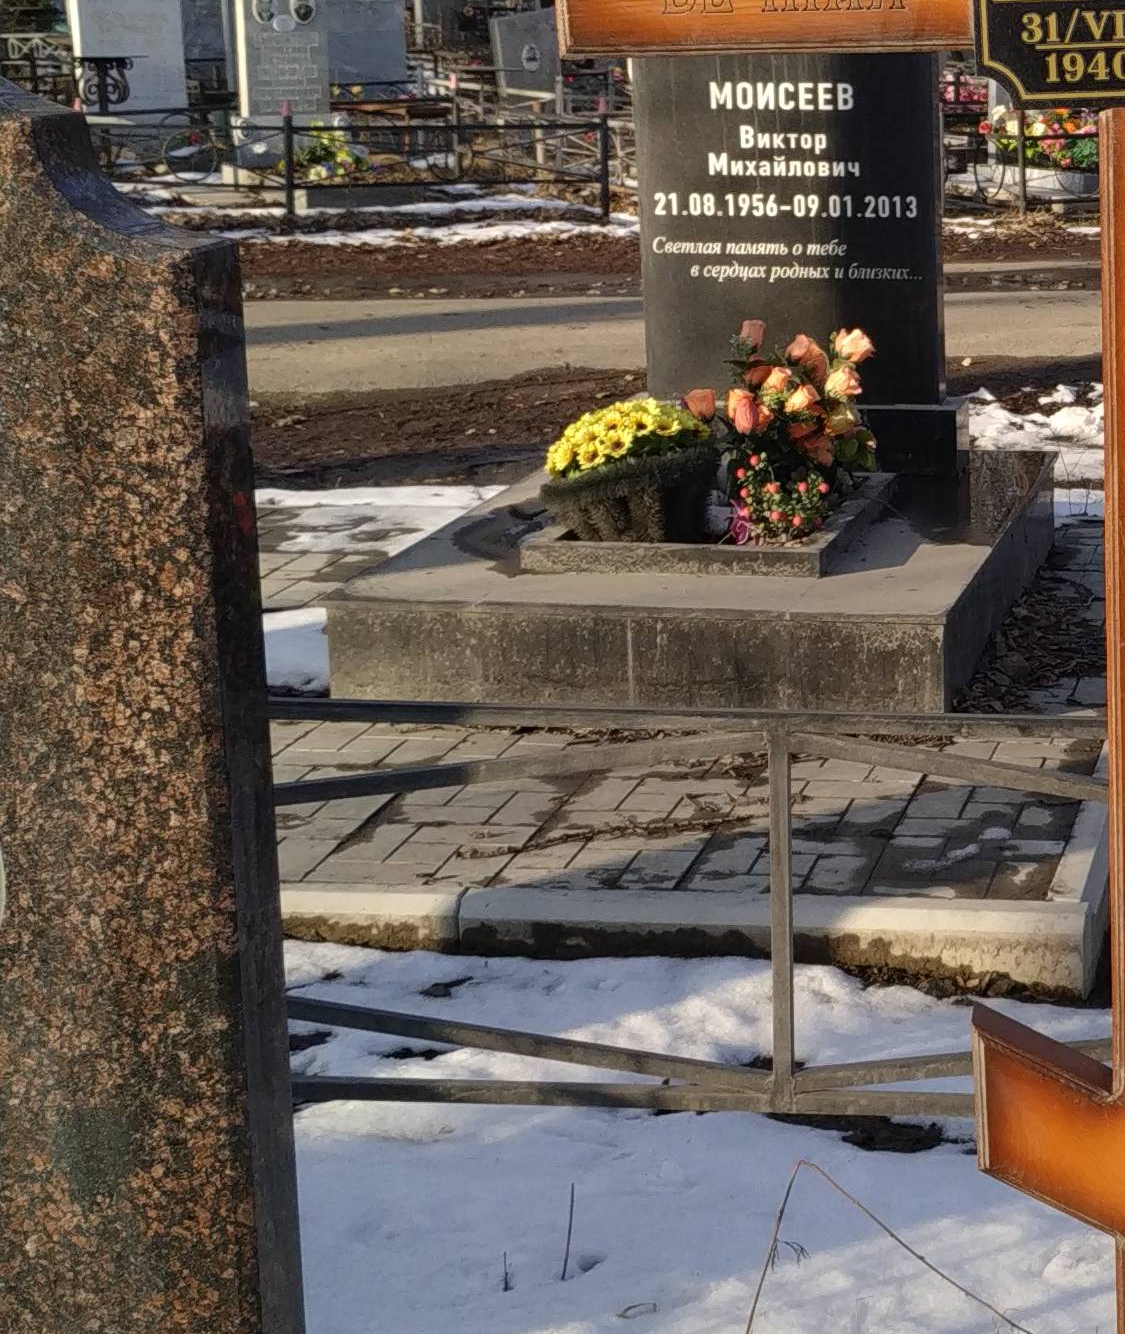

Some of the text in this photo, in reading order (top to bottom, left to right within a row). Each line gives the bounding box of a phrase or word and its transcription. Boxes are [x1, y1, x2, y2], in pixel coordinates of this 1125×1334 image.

[709, 81, 854, 111] МОИСЕЕВ
[739, 125, 827, 154] Виктор
[708, 152, 860, 177] Михайлович
[652, 236, 847, 256] Светлая память о тебе
[690, 263, 699, 277] в
[703, 261, 766, 282] сердцах
[769, 261, 829, 283] родных
[834, 268, 844, 279] и
